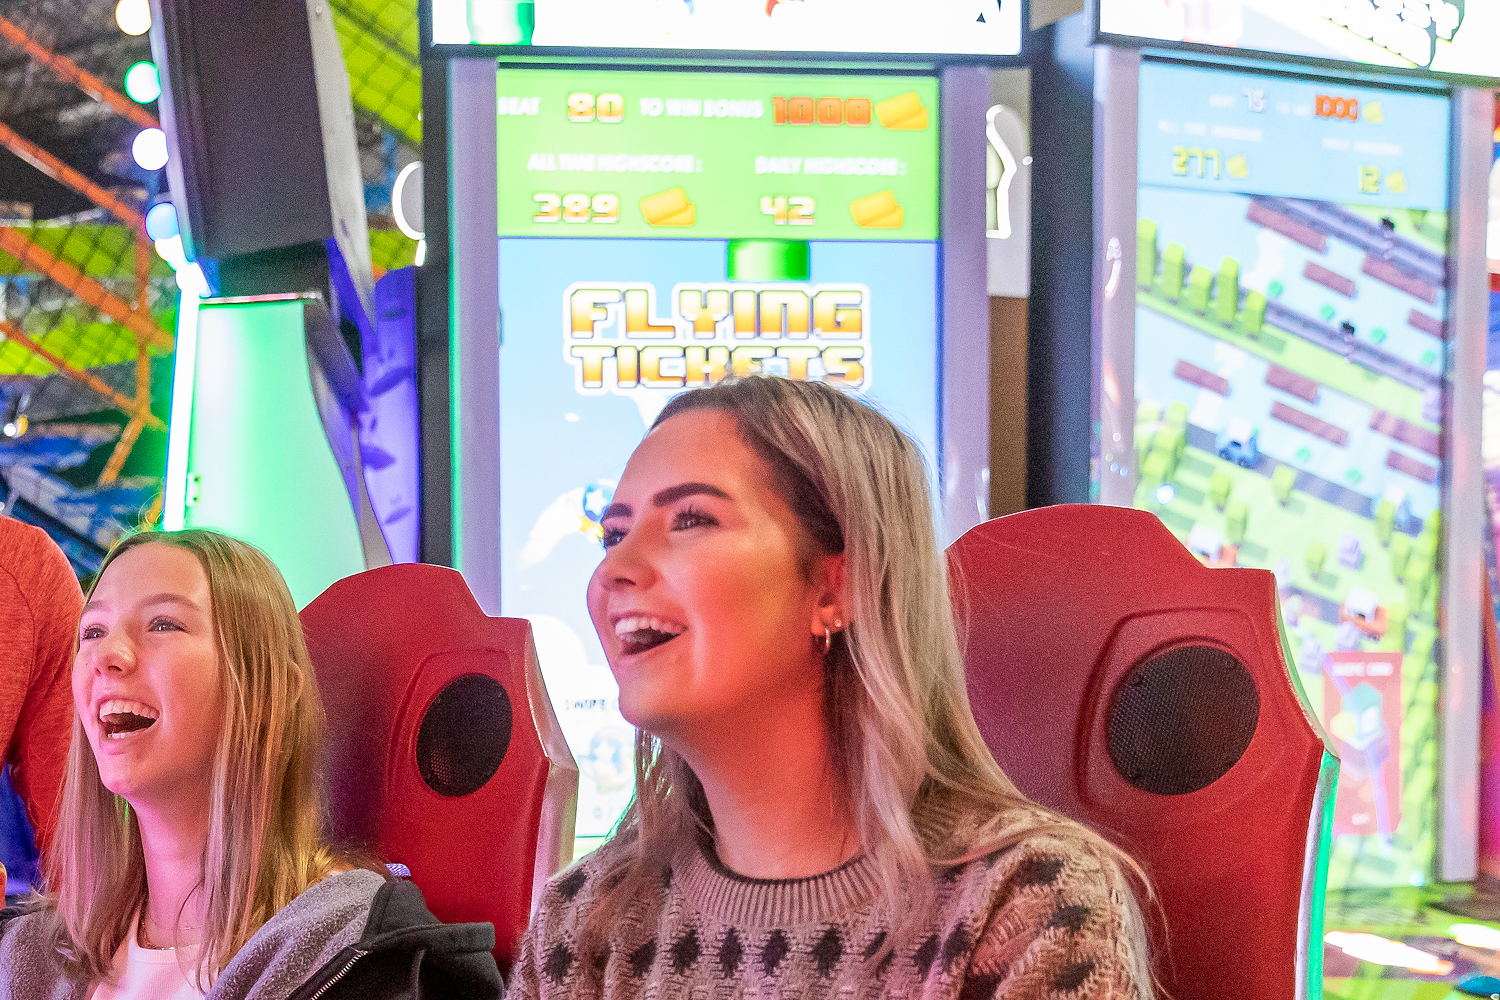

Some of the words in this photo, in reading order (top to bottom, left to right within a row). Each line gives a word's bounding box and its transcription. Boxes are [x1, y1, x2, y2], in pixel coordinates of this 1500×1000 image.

[498, 96, 541, 116] BEAT
[567, 93, 625, 123] 80
[639, 97, 665, 117] TO
[666, 99, 701, 117] WIN
[703, 99, 764, 119] BONUS
[772, 96, 872, 126] 1000
[527, 154, 557, 172] ALL
[558, 154, 596, 172] TIME
[754, 156, 804, 175] DAILY
[532, 193, 620, 224] 389
[760, 195, 816, 226] 42
[569, 288, 864, 340] FLYING
[569, 344, 866, 388] TICKETS
